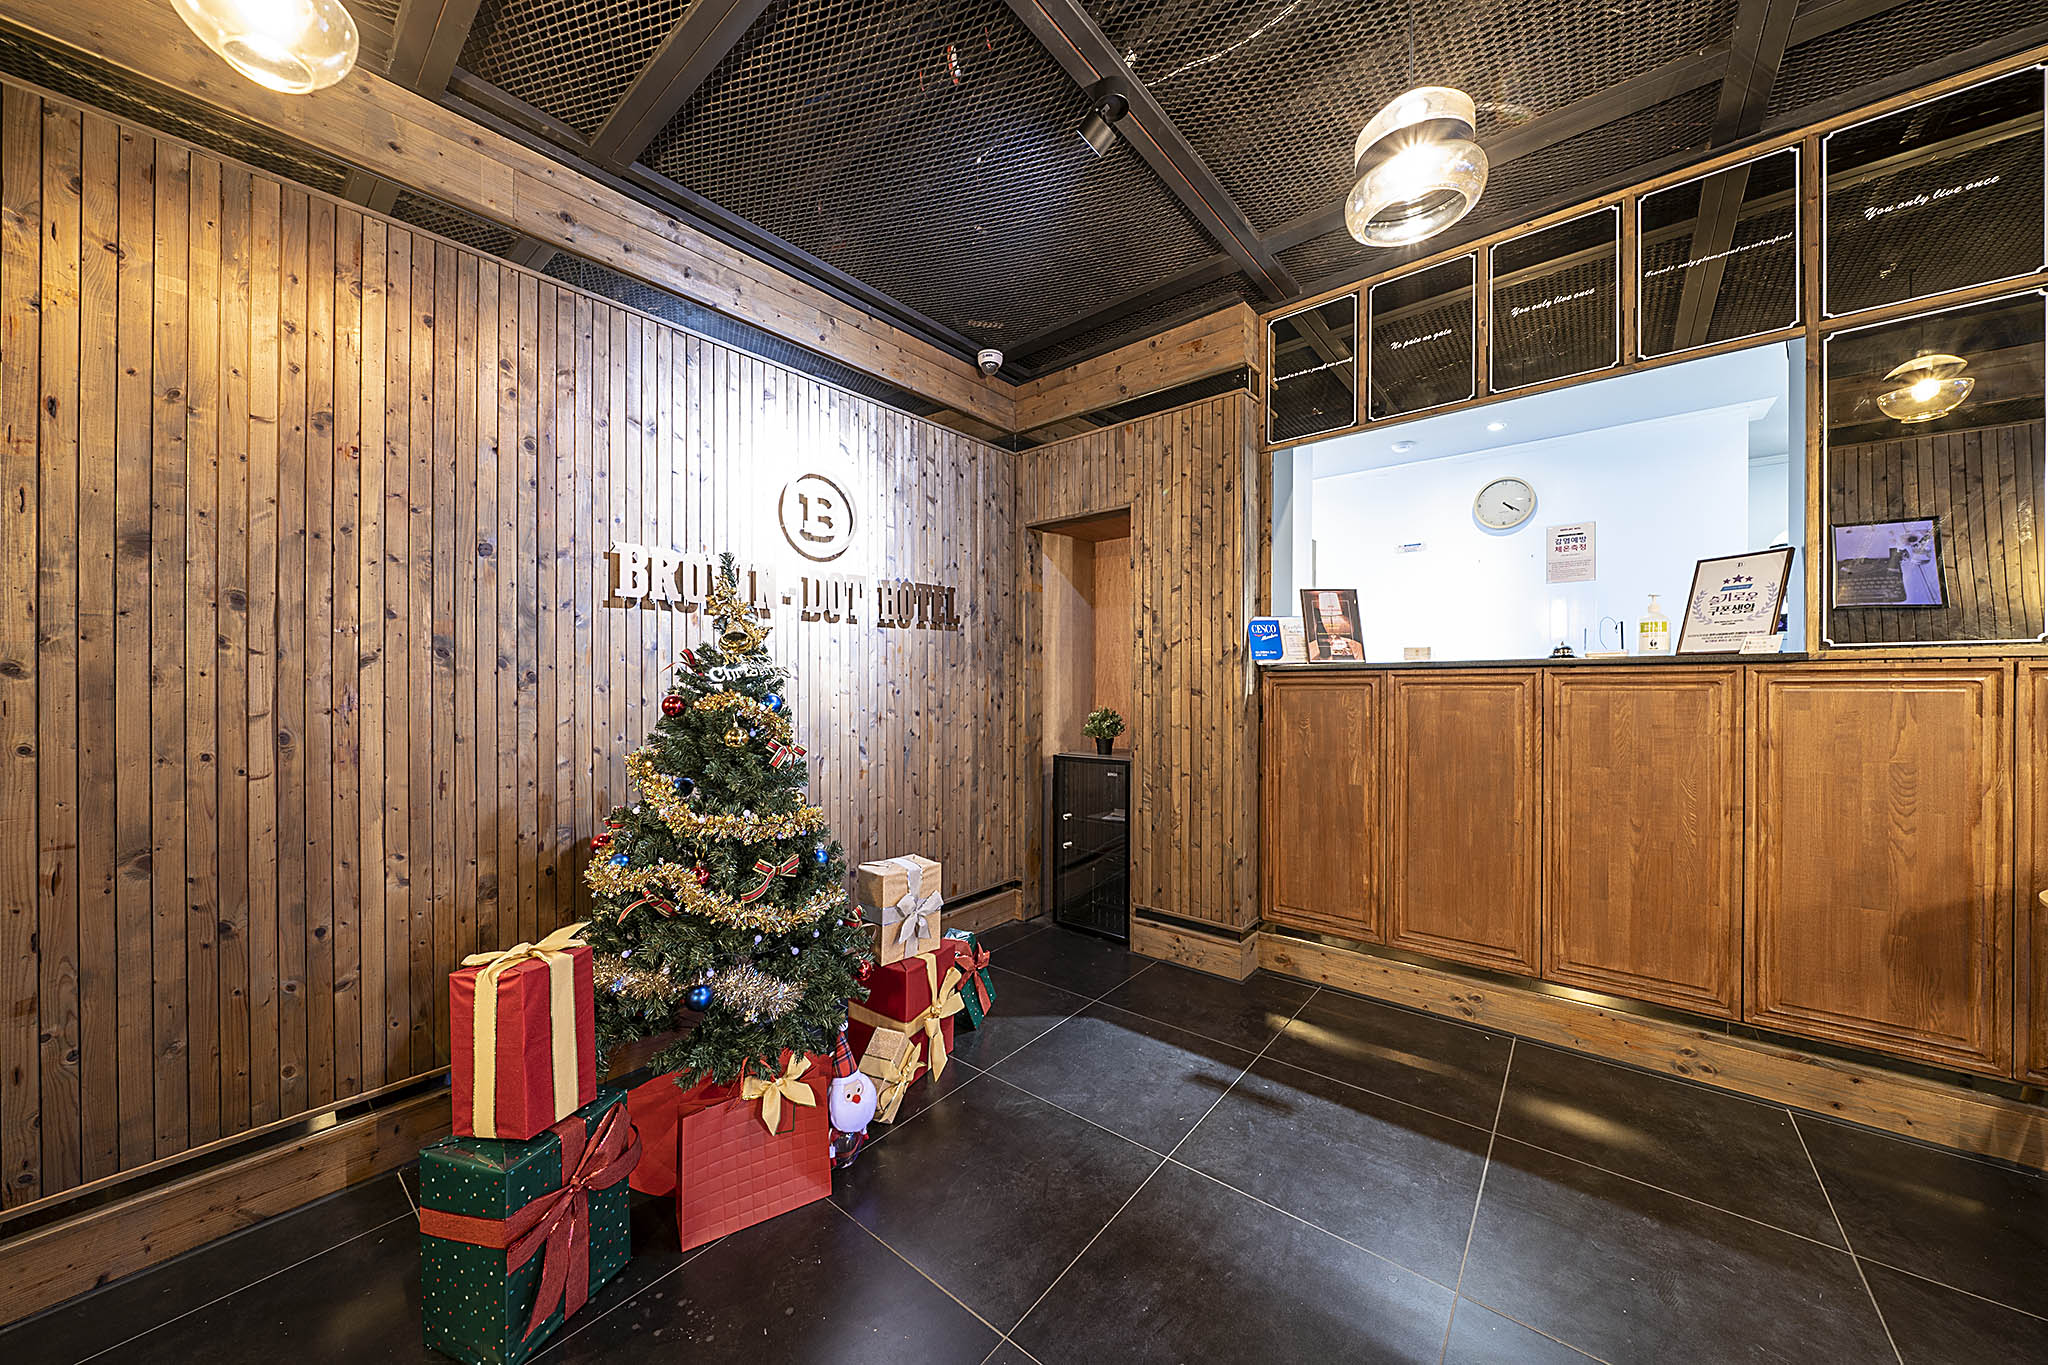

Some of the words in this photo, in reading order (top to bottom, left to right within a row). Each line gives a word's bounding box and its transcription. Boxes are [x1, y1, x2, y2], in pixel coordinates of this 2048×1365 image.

[1864, 206, 1895, 221] You
[1897, 193, 1930, 210] only
[1932, 185, 1963, 200] live
[1965, 175, 2001, 191] once
[1510, 306, 1531, 318] You
[1531, 299, 1553, 311] only
[1553, 295, 1573, 306] live
[1573, 287, 1596, 299] once
[1390, 341, 1402, 350] No
[1402, 336, 1422, 349] pain
[1422, 334, 1433, 342] no
[1432, 328, 1453, 341] gain
[877, 579, 960, 631] HOTEL
[1708, 592, 1758, 606] 슬기로운
[1708, 602, 1756, 616] 쿠폰생활
[1251, 624, 1277, 634] CESCO
